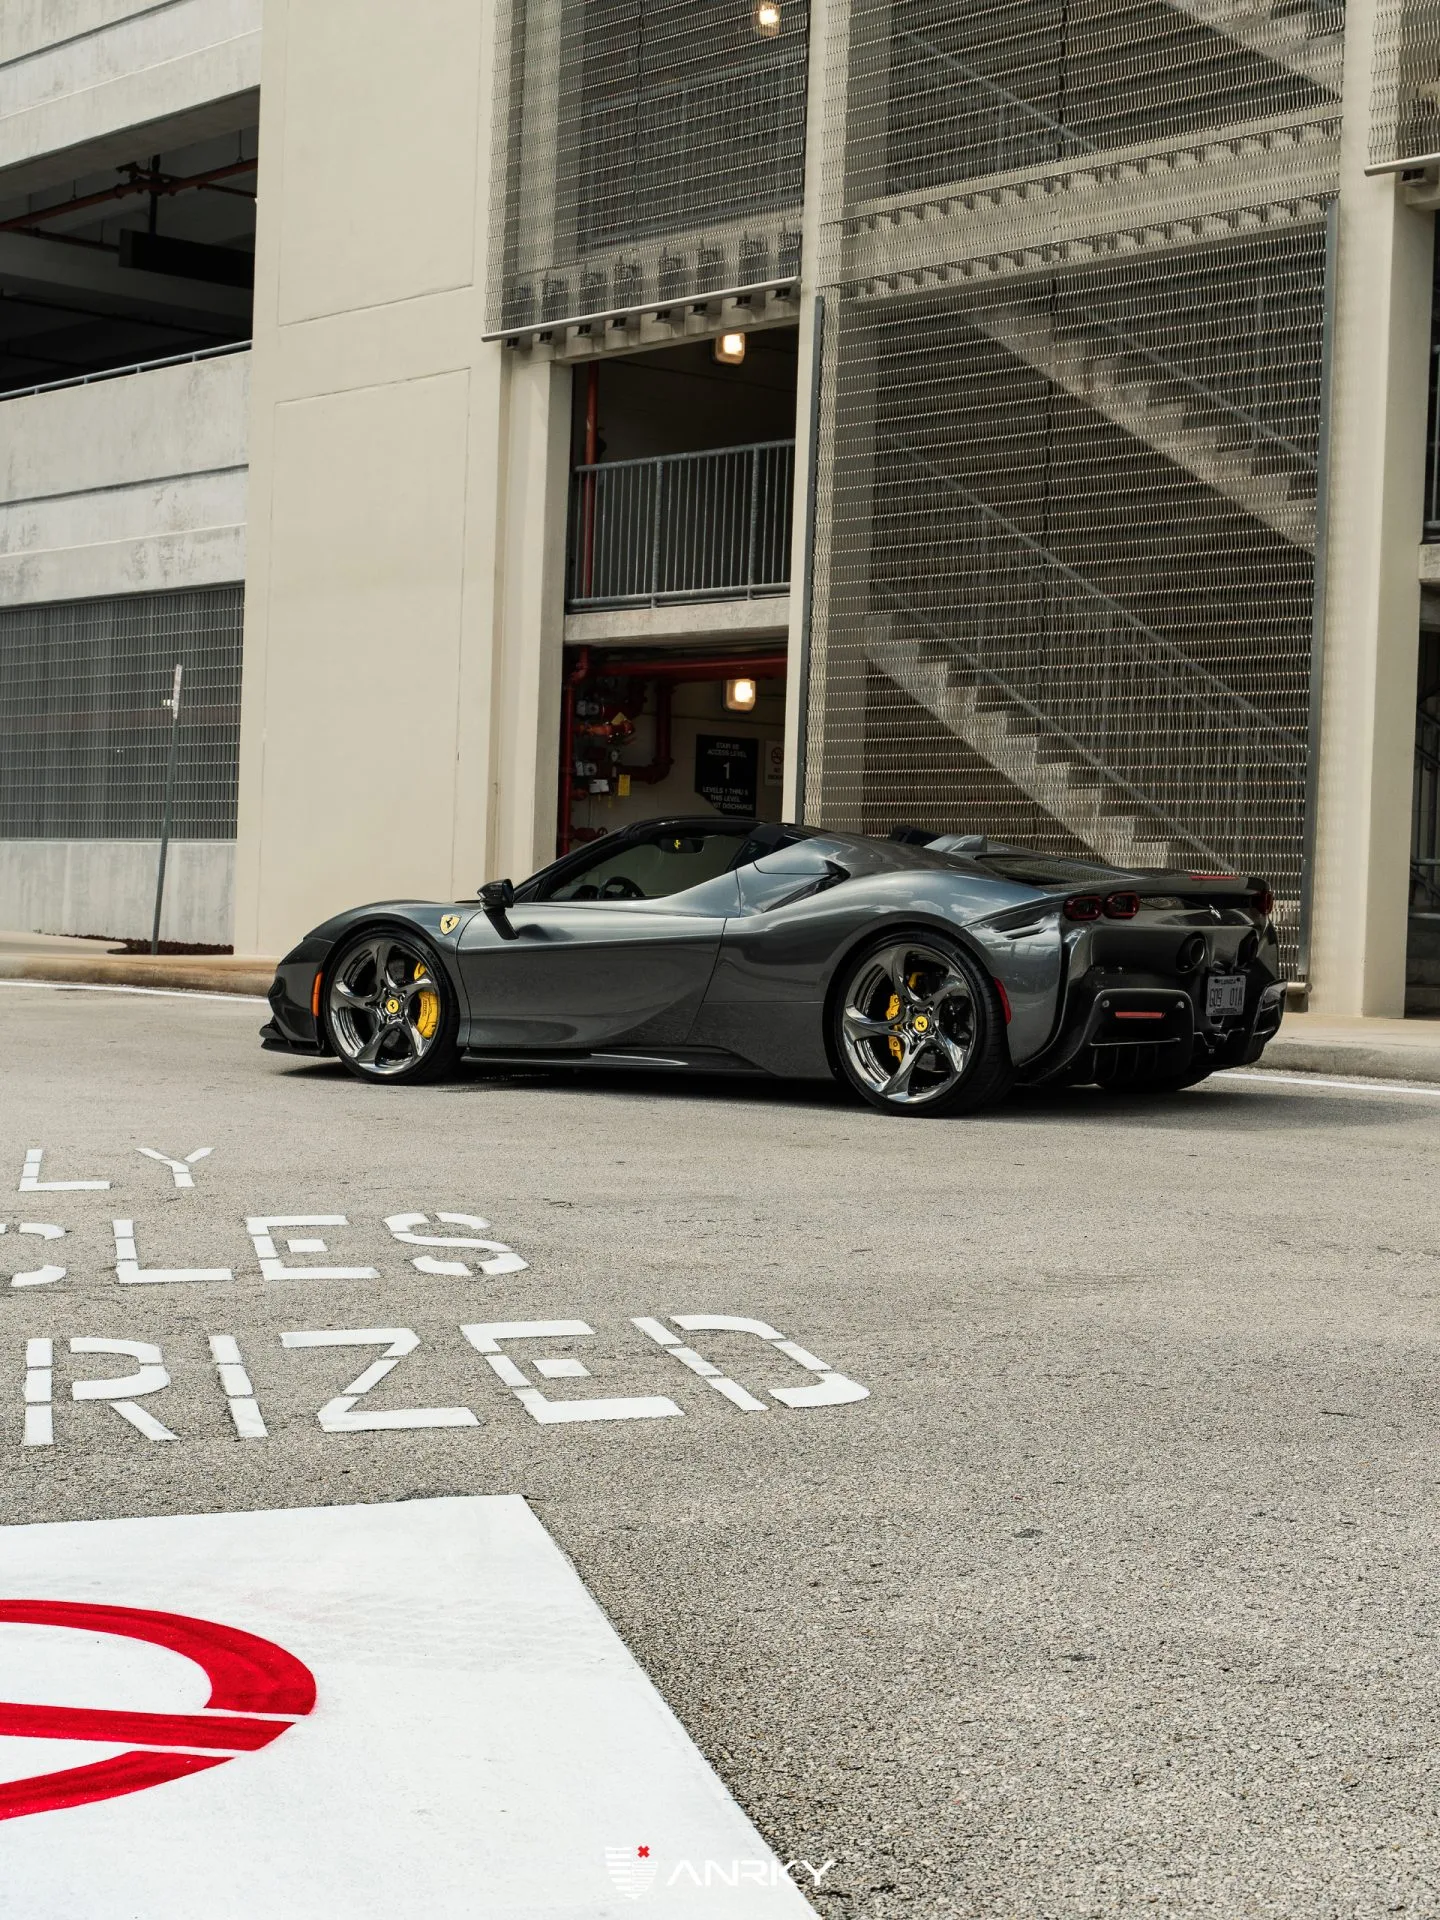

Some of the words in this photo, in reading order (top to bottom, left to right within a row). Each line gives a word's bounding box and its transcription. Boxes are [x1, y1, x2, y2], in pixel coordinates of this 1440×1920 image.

[722, 761, 730, 780] 1
[702, 786, 724, 794] LEVELS
[728, 788, 744, 796] THRU
[710, 794, 722, 802] THIS
[18, 1147, 214, 1191] LY
[24, 1314, 871, 1447] RIZED
